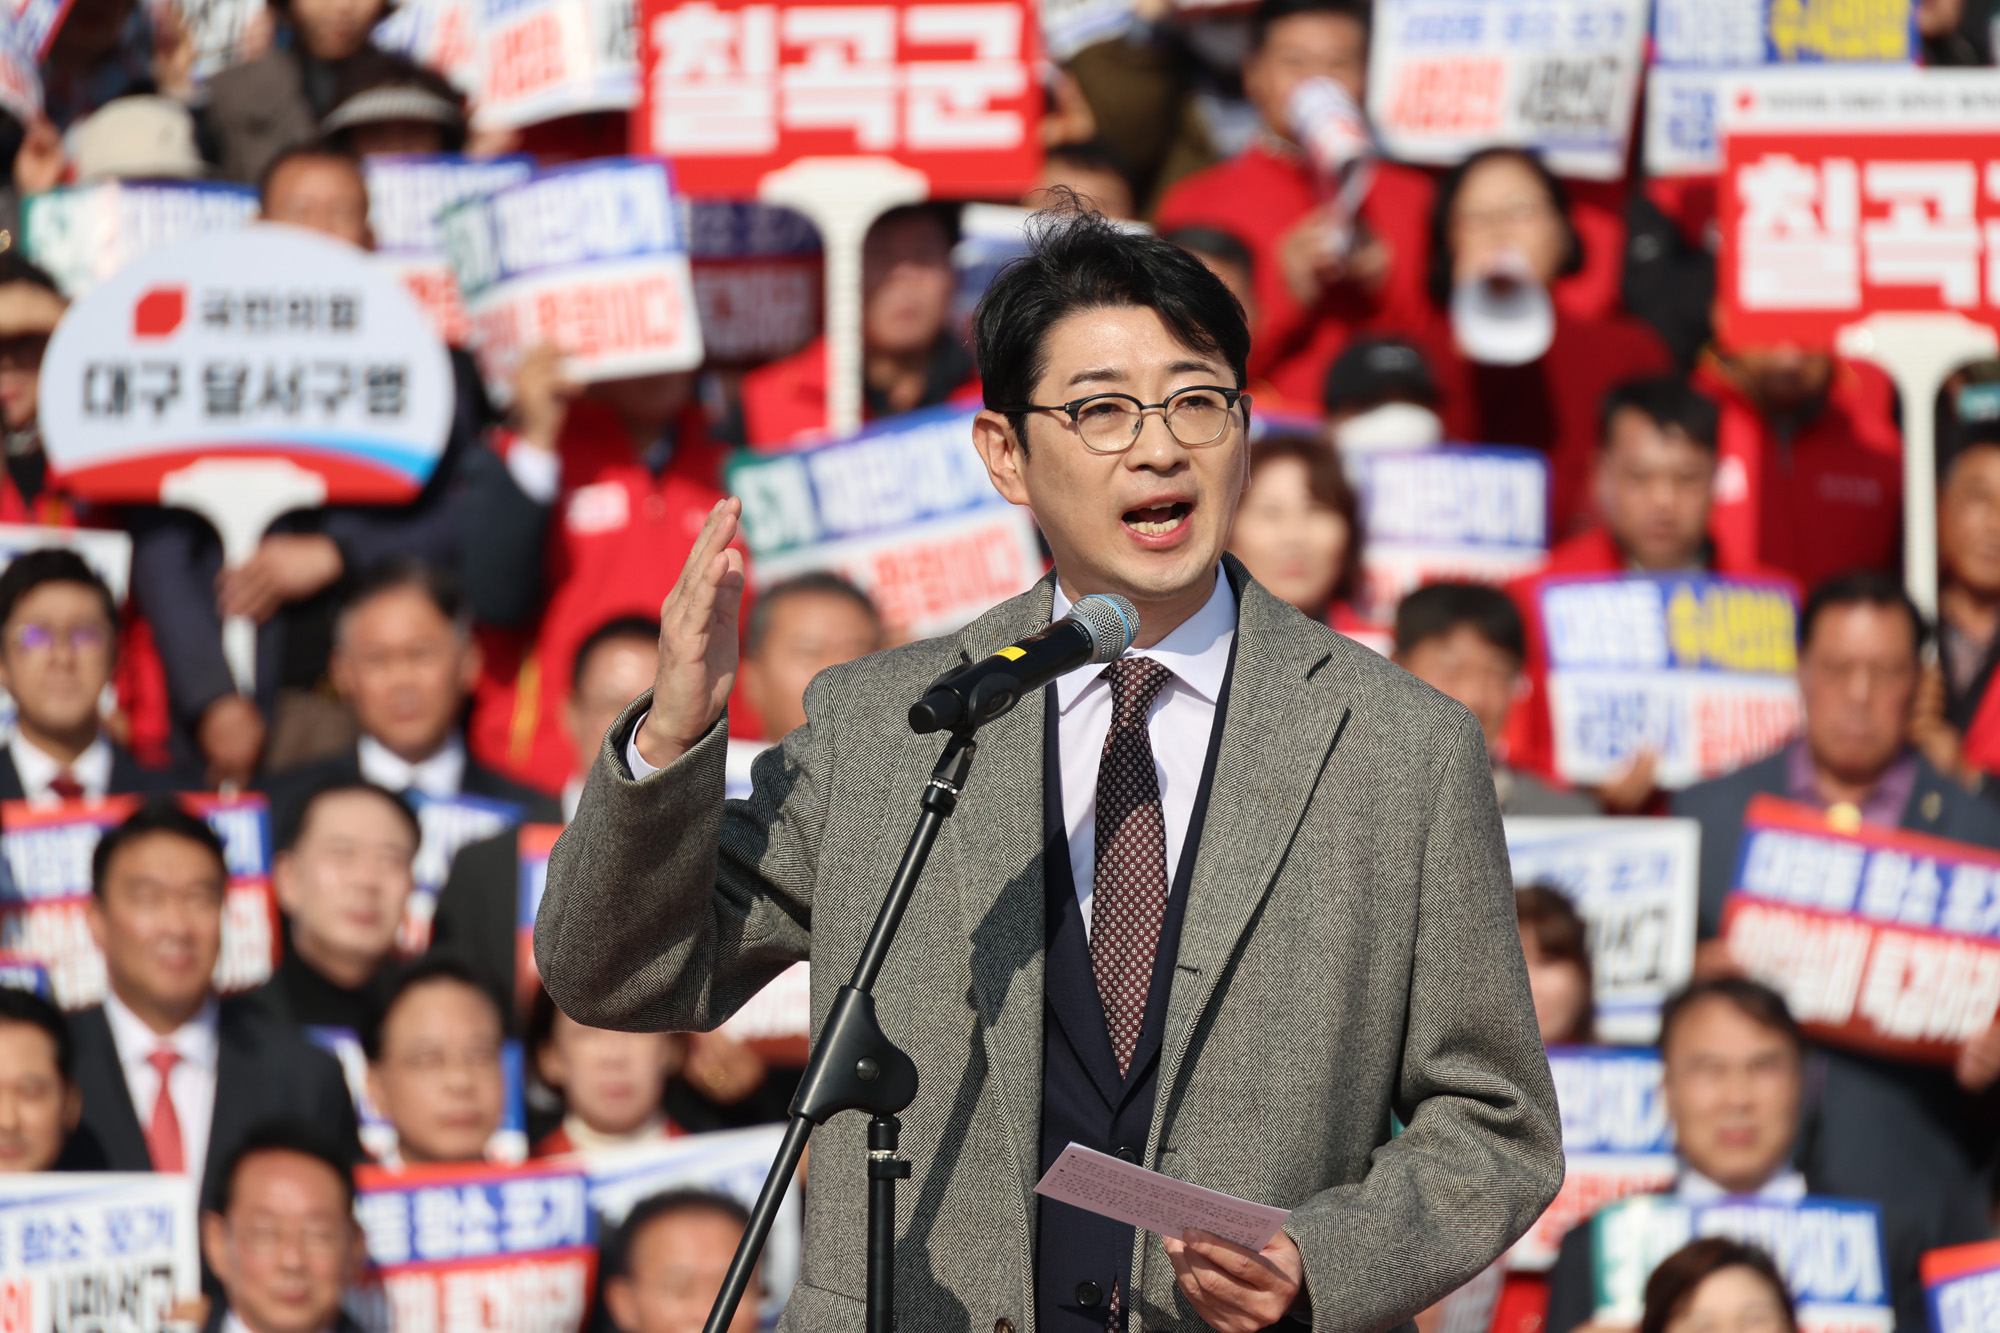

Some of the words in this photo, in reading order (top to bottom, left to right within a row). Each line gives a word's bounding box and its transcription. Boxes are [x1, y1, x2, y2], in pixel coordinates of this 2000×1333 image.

[651, 3, 1028, 154] 칠곡군
[1737, 152, 2000, 312] 칠곡
[201, 288, 360, 332] 국민의힘
[82, 359, 181, 421] 대구
[201, 358, 409, 421] 달서구병
